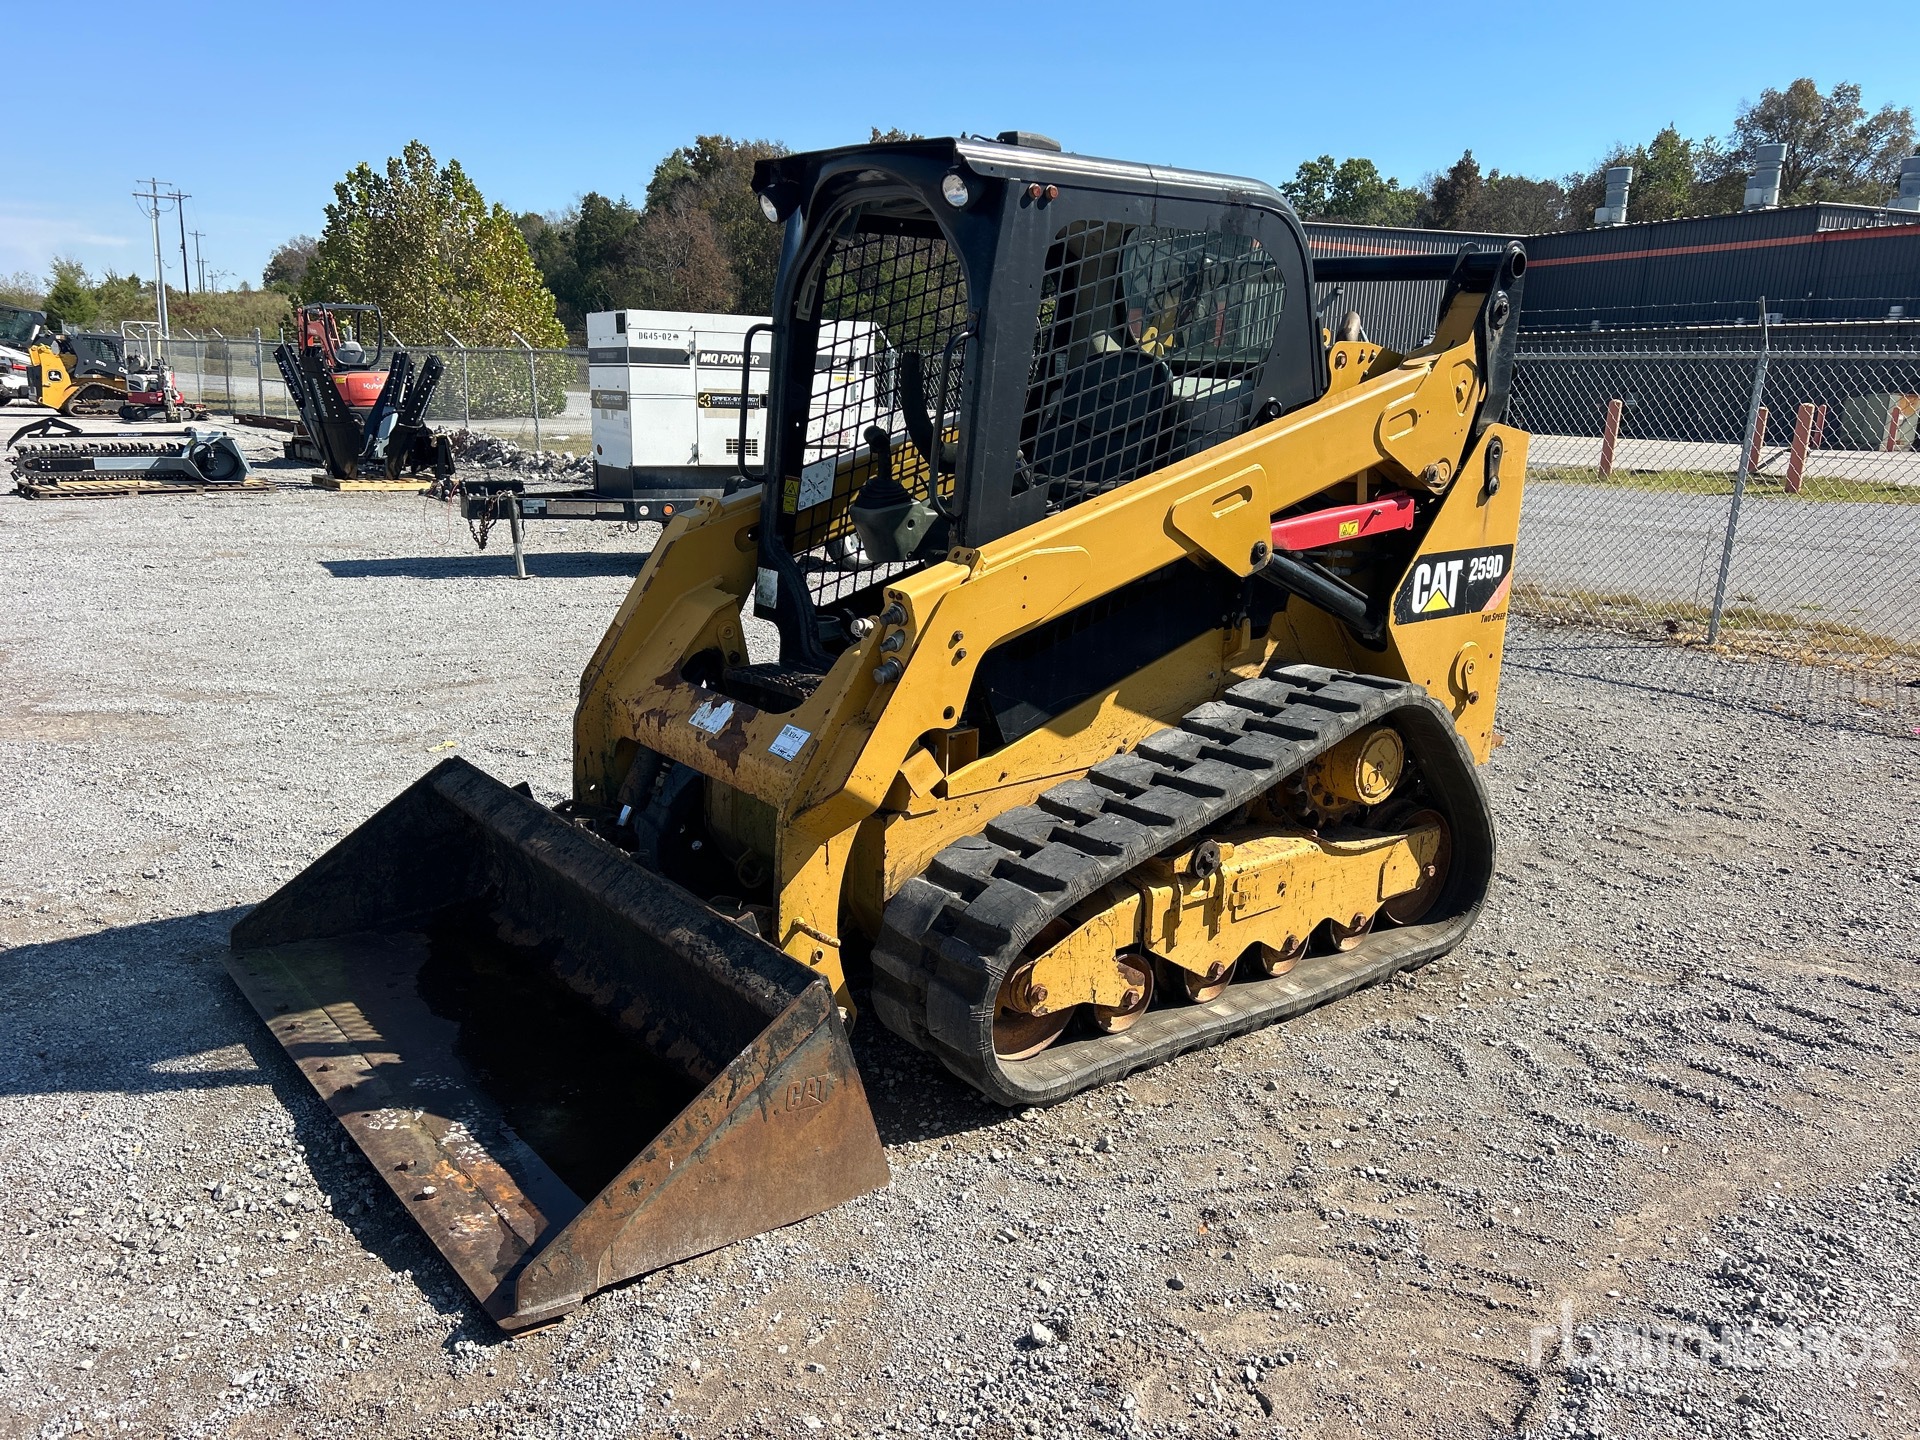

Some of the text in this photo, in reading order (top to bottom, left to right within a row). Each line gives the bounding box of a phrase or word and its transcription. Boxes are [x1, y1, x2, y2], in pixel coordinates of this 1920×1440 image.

[638, 331, 672, 341] DG45-02
[700, 352, 760, 365] MQ POWR
[1411, 554, 1504, 614] CAT 259D
[786, 1073, 830, 1112] CAT
